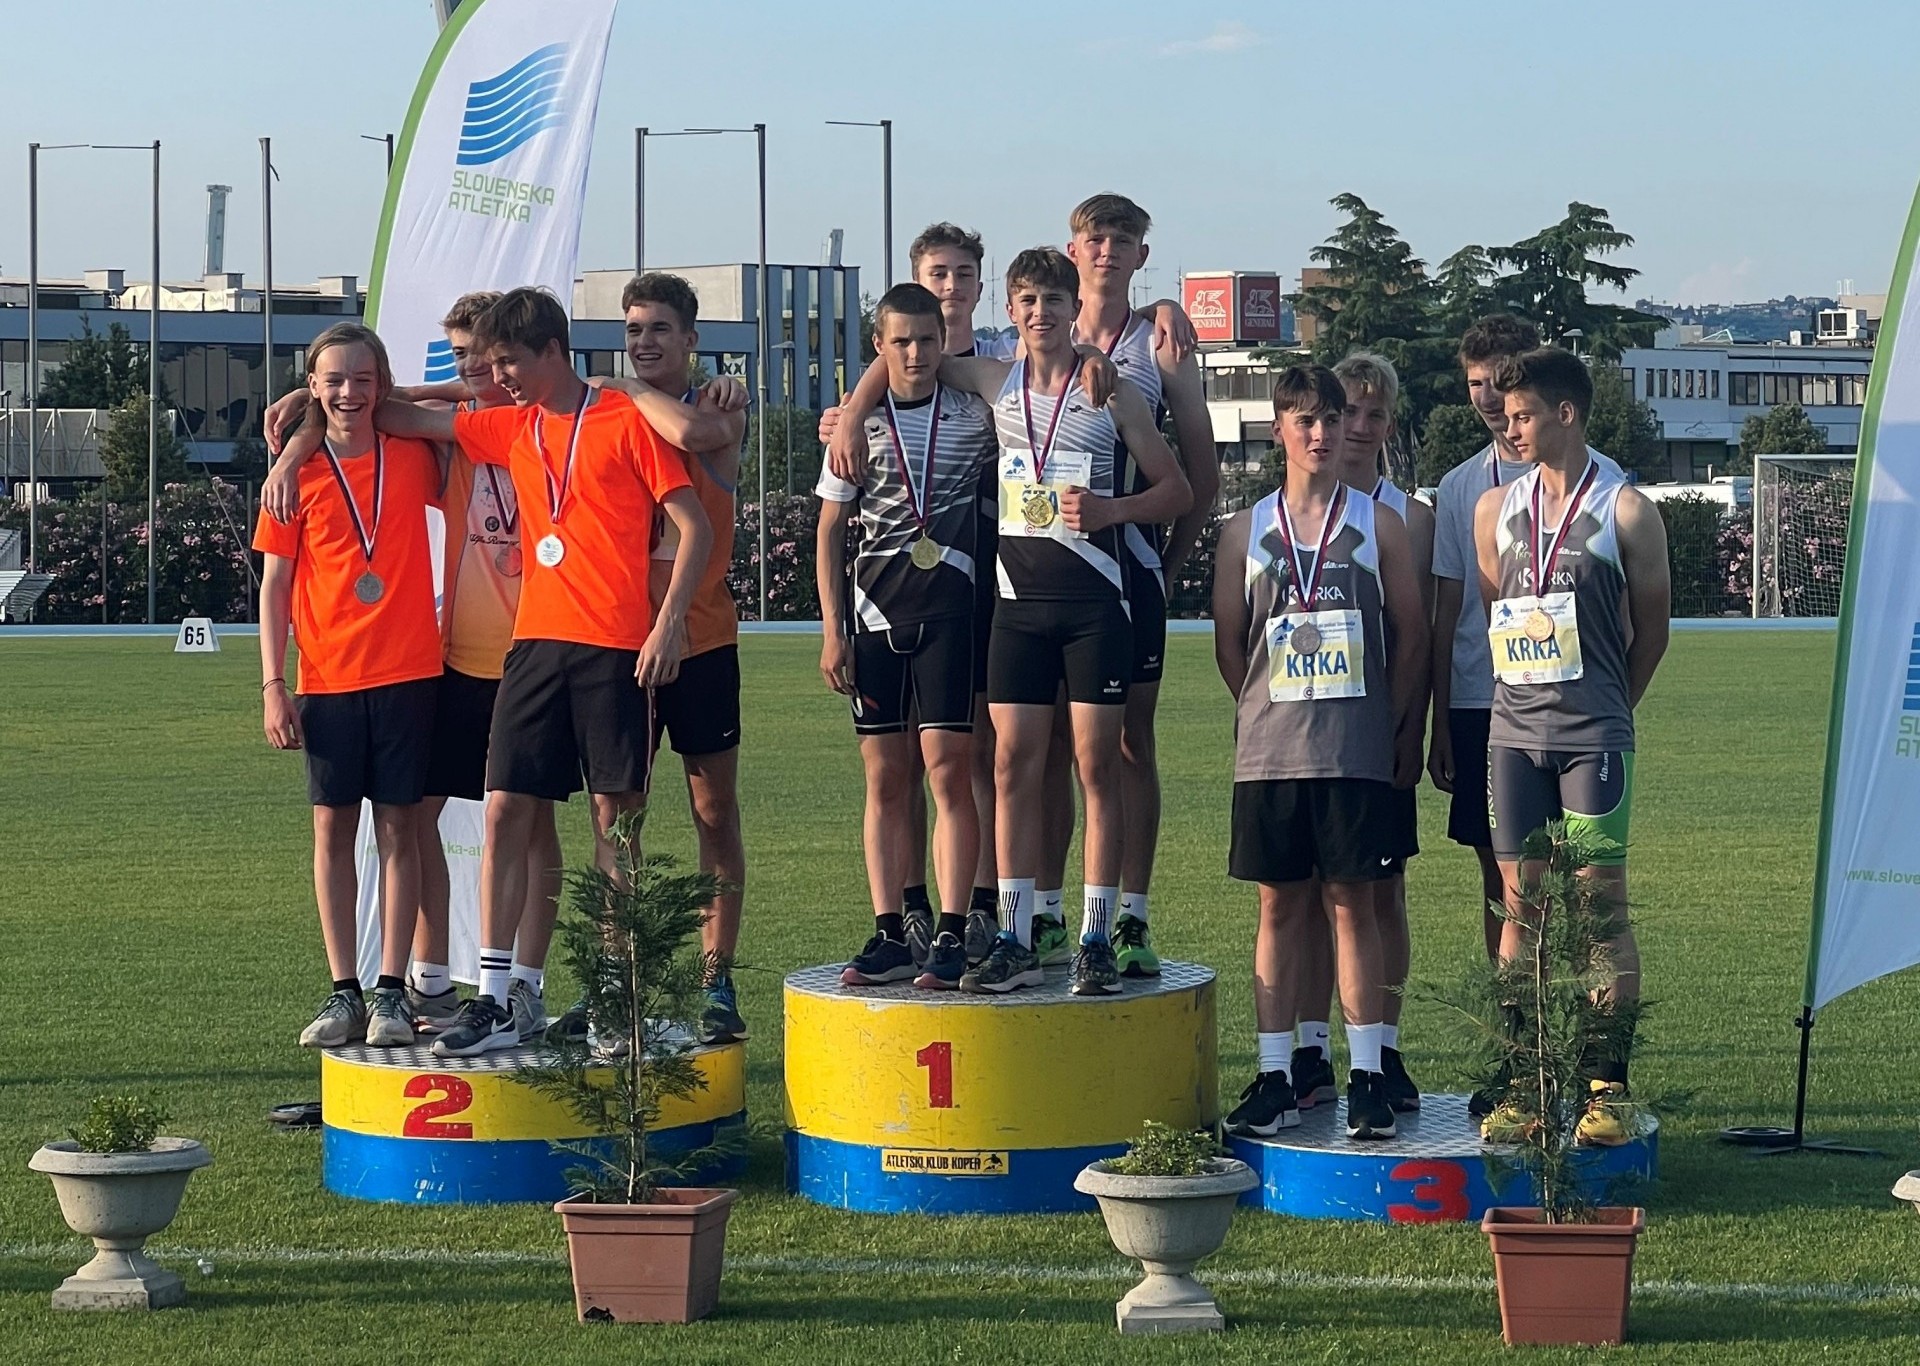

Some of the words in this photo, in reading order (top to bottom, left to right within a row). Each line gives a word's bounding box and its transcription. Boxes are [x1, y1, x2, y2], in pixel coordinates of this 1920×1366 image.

[452, 170, 555, 206] SLOVENSKA
[448, 191, 531, 223] ATLETIKA
[1244, 318, 1275, 328] GENERALI
[1314, 586, 1346, 600] RKA
[184, 626, 205, 645] 65
[1505, 636, 1562, 662] KRKA
[1286, 650, 1349, 678] KRKA
[916, 1041, 953, 1108] 1
[403, 1073, 473, 1138] 2
[886, 1154, 923, 1168] ATLETSKI
[926, 1156, 949, 1169] KLUB
[952, 1157, 980, 1170] KOPER
[1387, 1158, 1470, 1223] 3
